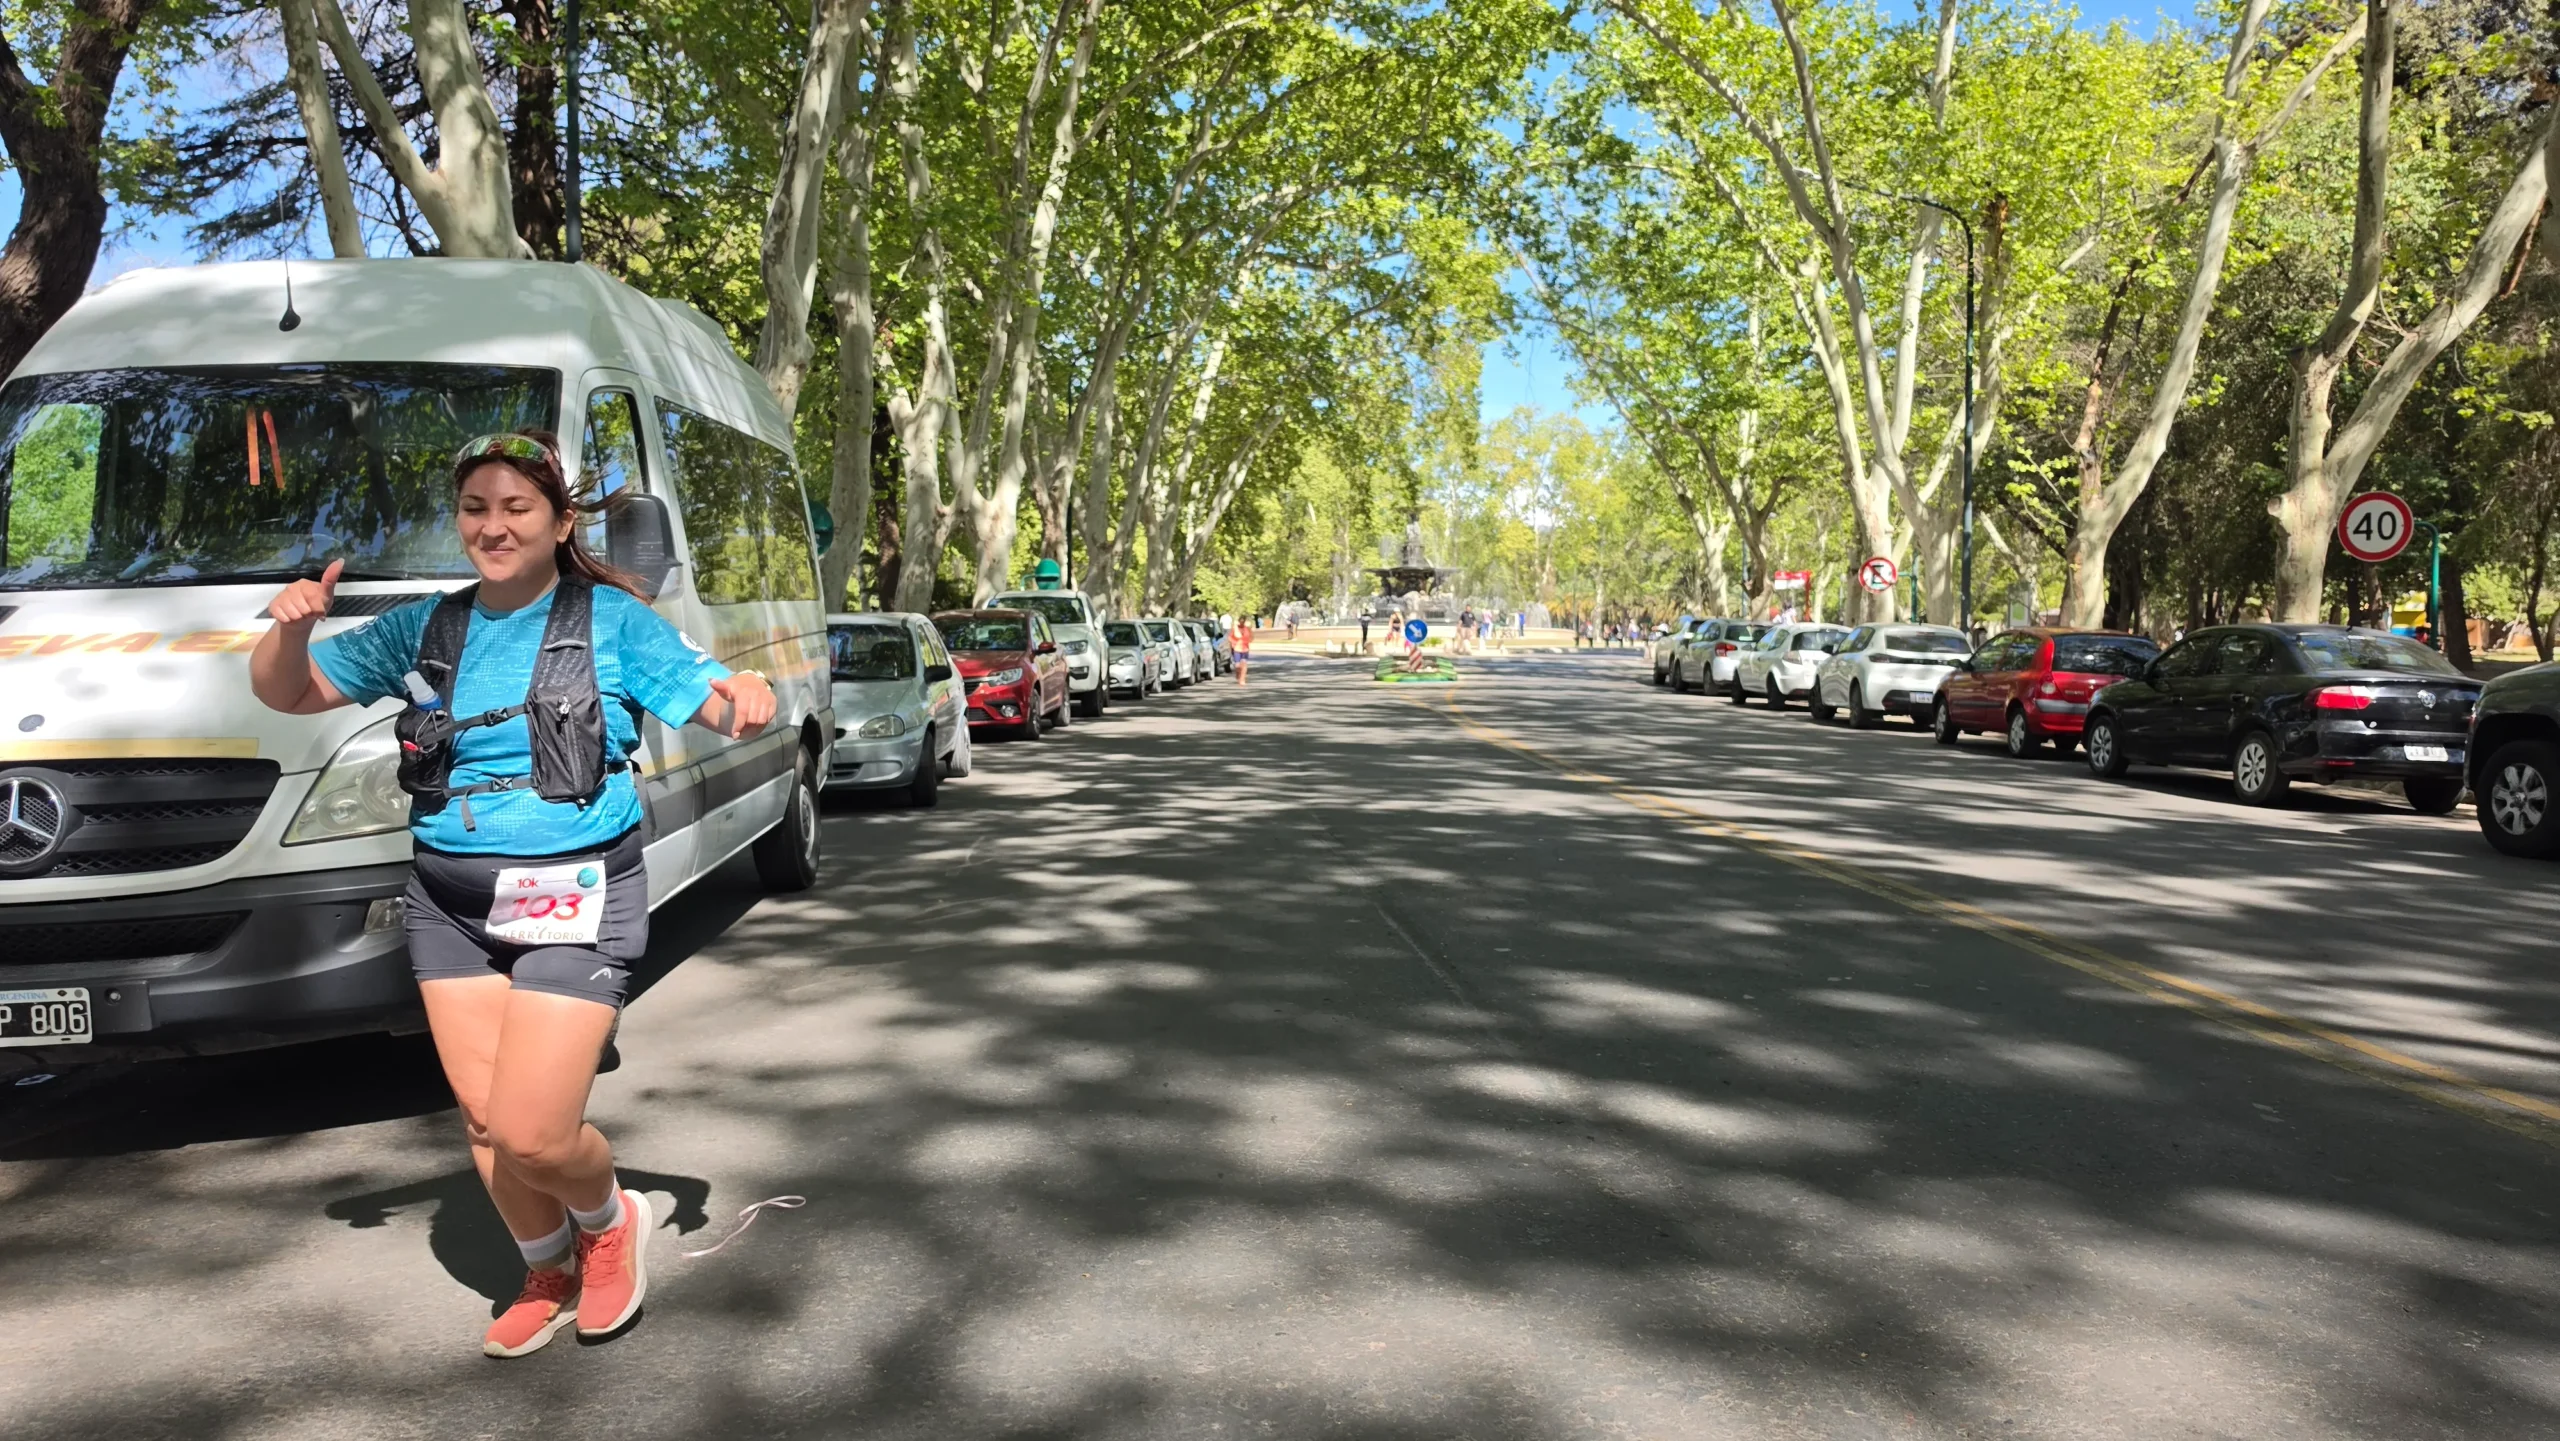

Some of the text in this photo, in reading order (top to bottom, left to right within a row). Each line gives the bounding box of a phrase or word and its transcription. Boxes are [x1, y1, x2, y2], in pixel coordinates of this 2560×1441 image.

[2352, 511, 2397, 541] 40
[517, 877, 539, 889] 10k
[511, 892, 585, 921] 103
[30, 1003, 86, 1034] 806
